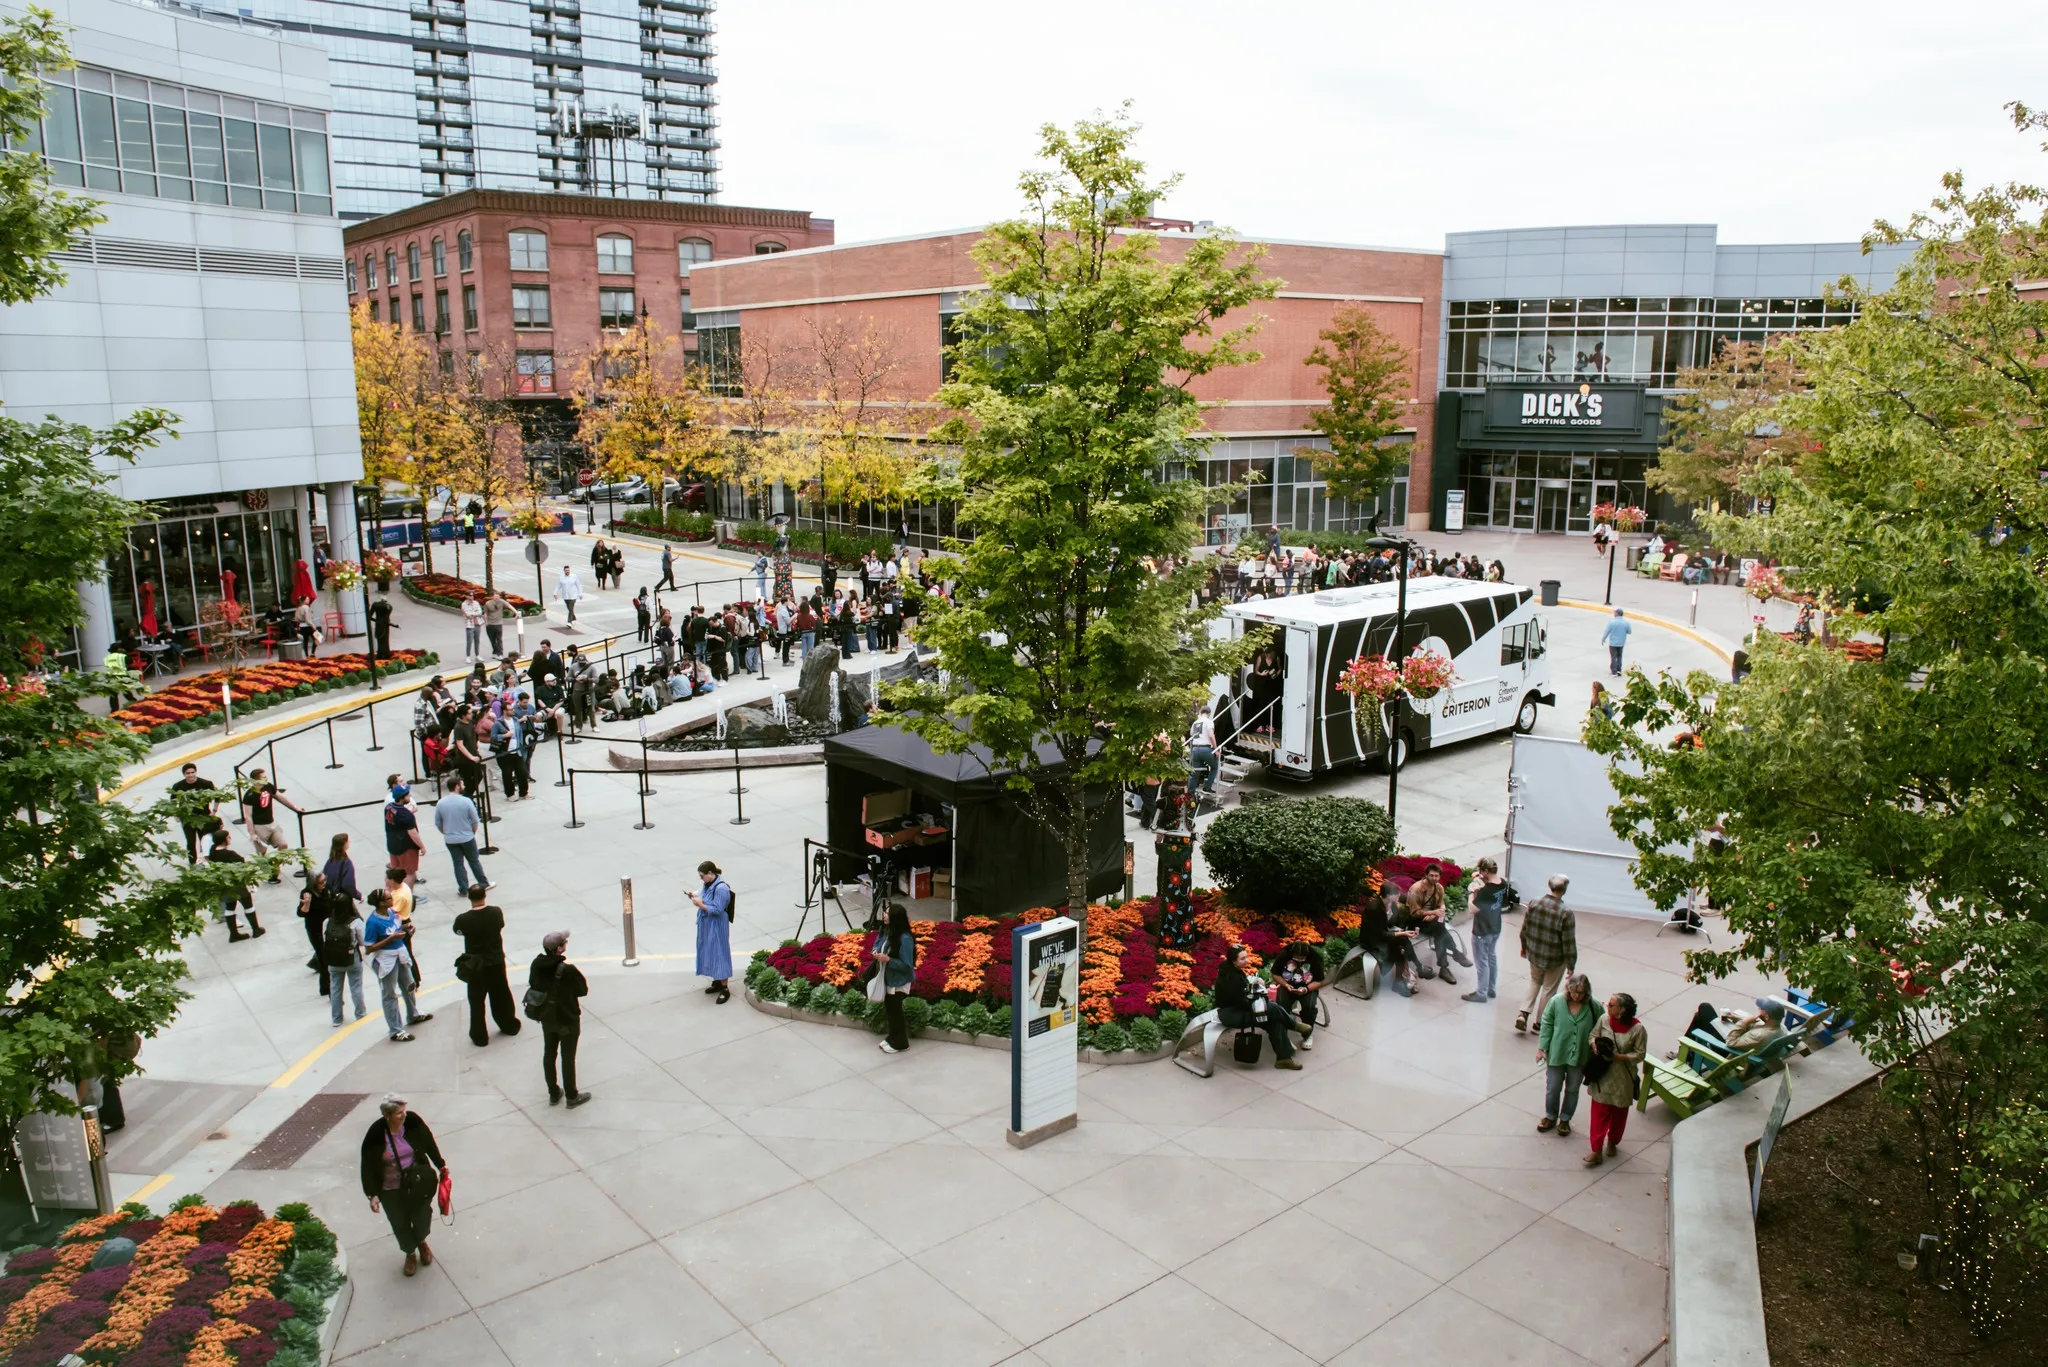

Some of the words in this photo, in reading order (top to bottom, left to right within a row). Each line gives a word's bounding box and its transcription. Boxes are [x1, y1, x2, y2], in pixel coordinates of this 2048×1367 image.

[1522, 390, 1603, 417] DICK'S
[580, 473, 592, 481] STOP
[1499, 686, 1518, 695] Criterion
[1442, 696, 1490, 718] CRITERION
[1041, 940, 1065, 958] WE'VE
